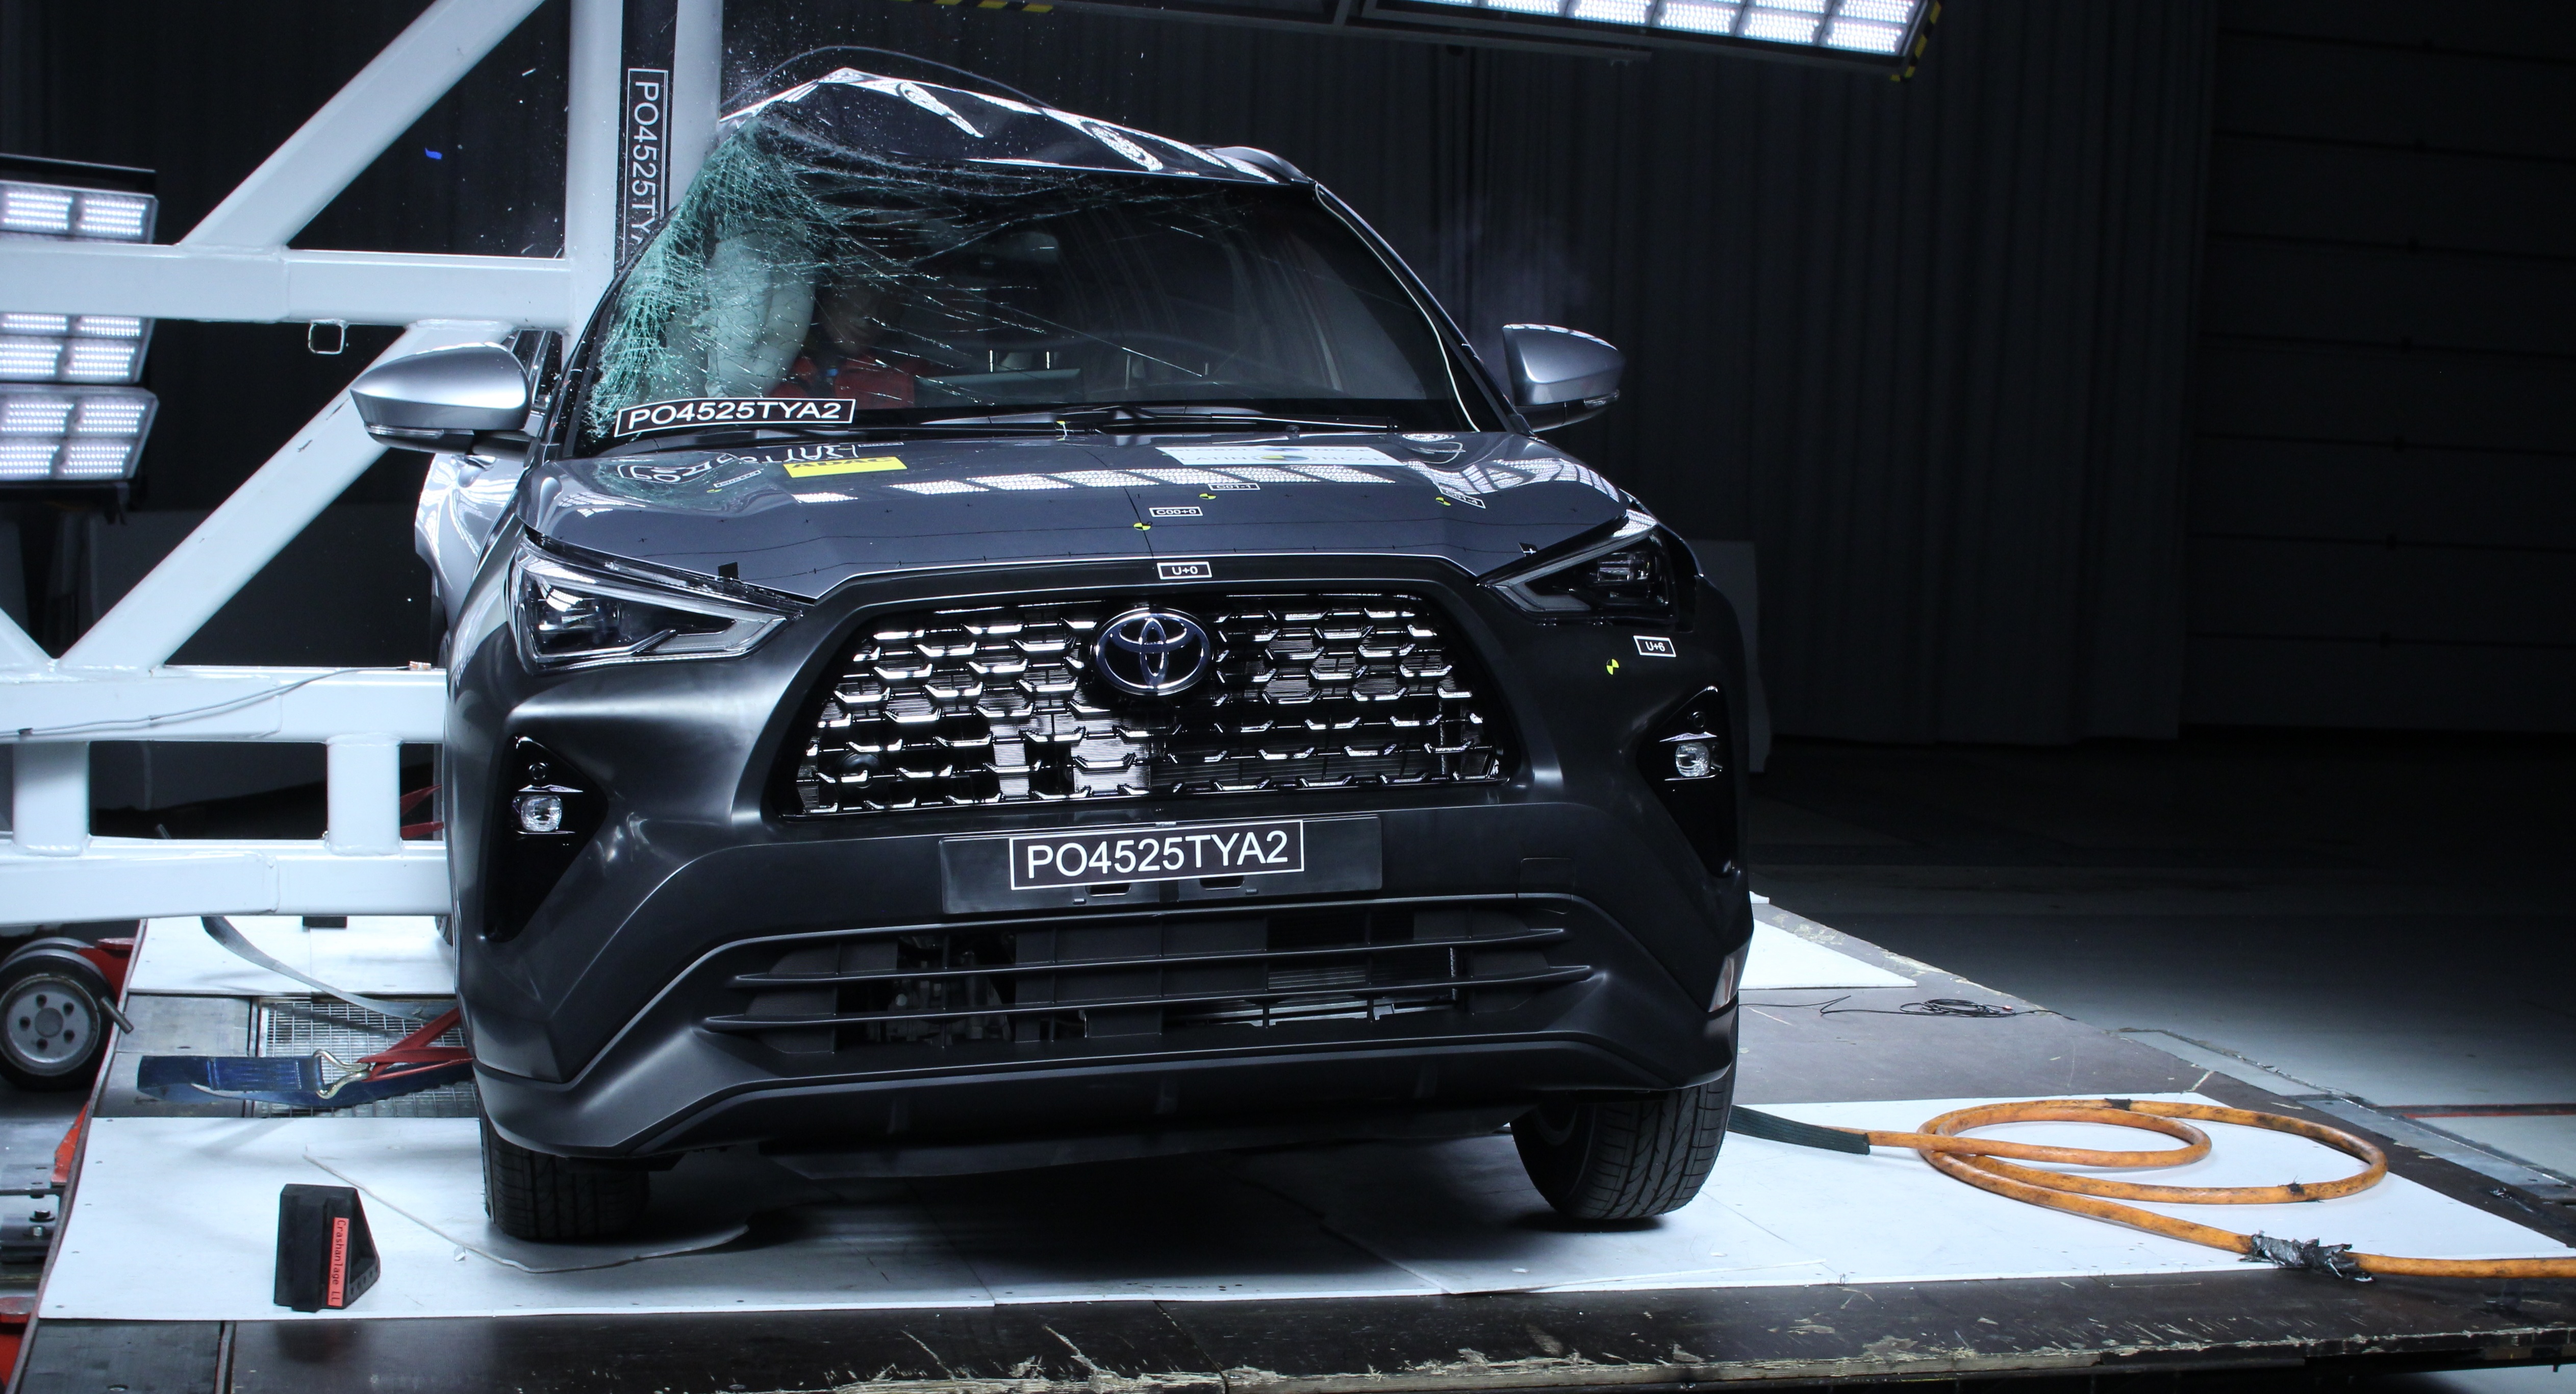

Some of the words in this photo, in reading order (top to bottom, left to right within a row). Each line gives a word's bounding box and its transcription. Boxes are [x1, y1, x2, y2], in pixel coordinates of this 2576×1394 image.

[628, 402, 842, 430] PO4525TYA2
[792, 457, 893, 468] ADAC
[1172, 566, 1198, 575] U+0
[1645, 641, 1665, 652] U+6
[1026, 830, 1289, 879] PO4525TYA2
[332, 1220, 346, 1285] Crashanlage
